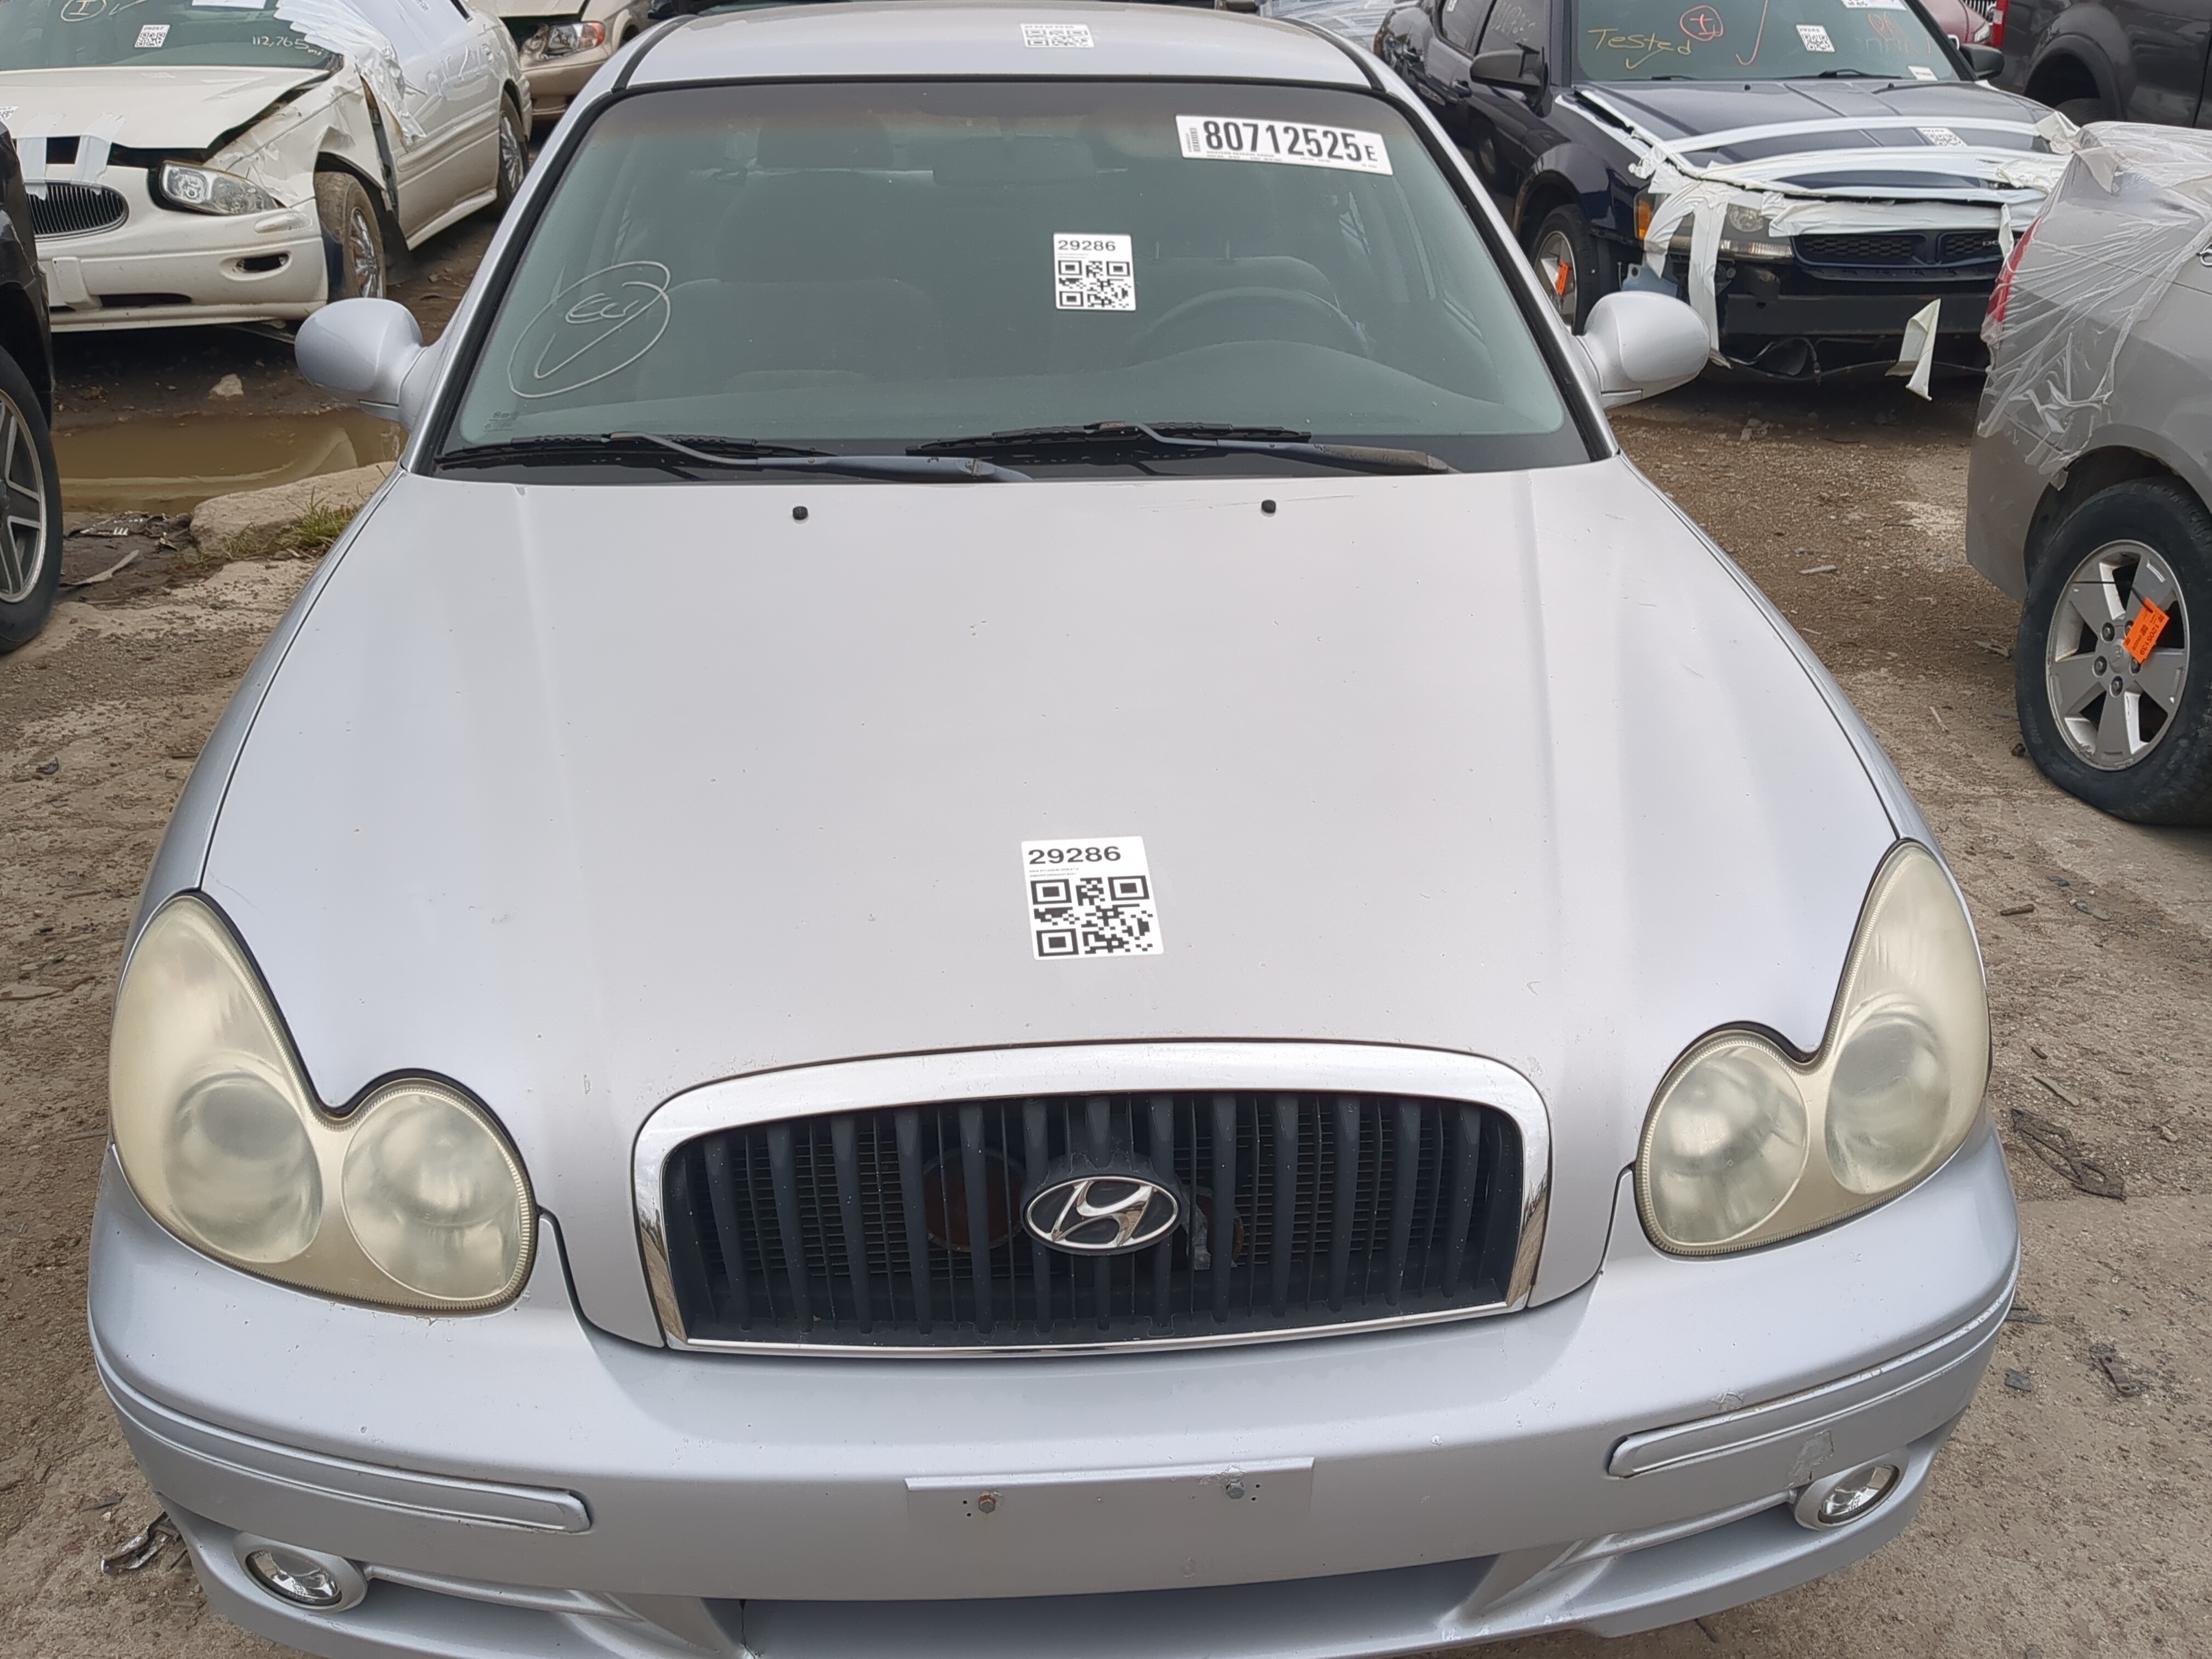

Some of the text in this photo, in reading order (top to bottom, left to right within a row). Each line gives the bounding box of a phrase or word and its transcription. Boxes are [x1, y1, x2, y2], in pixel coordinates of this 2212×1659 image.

[252, 36, 309, 49] 112,765
[1588, 28, 1691, 55] Tested
[1058, 240, 1116, 251] 29286
[2140, 624, 2159, 656] 1205139
[1028, 846, 1121, 865] 29286
